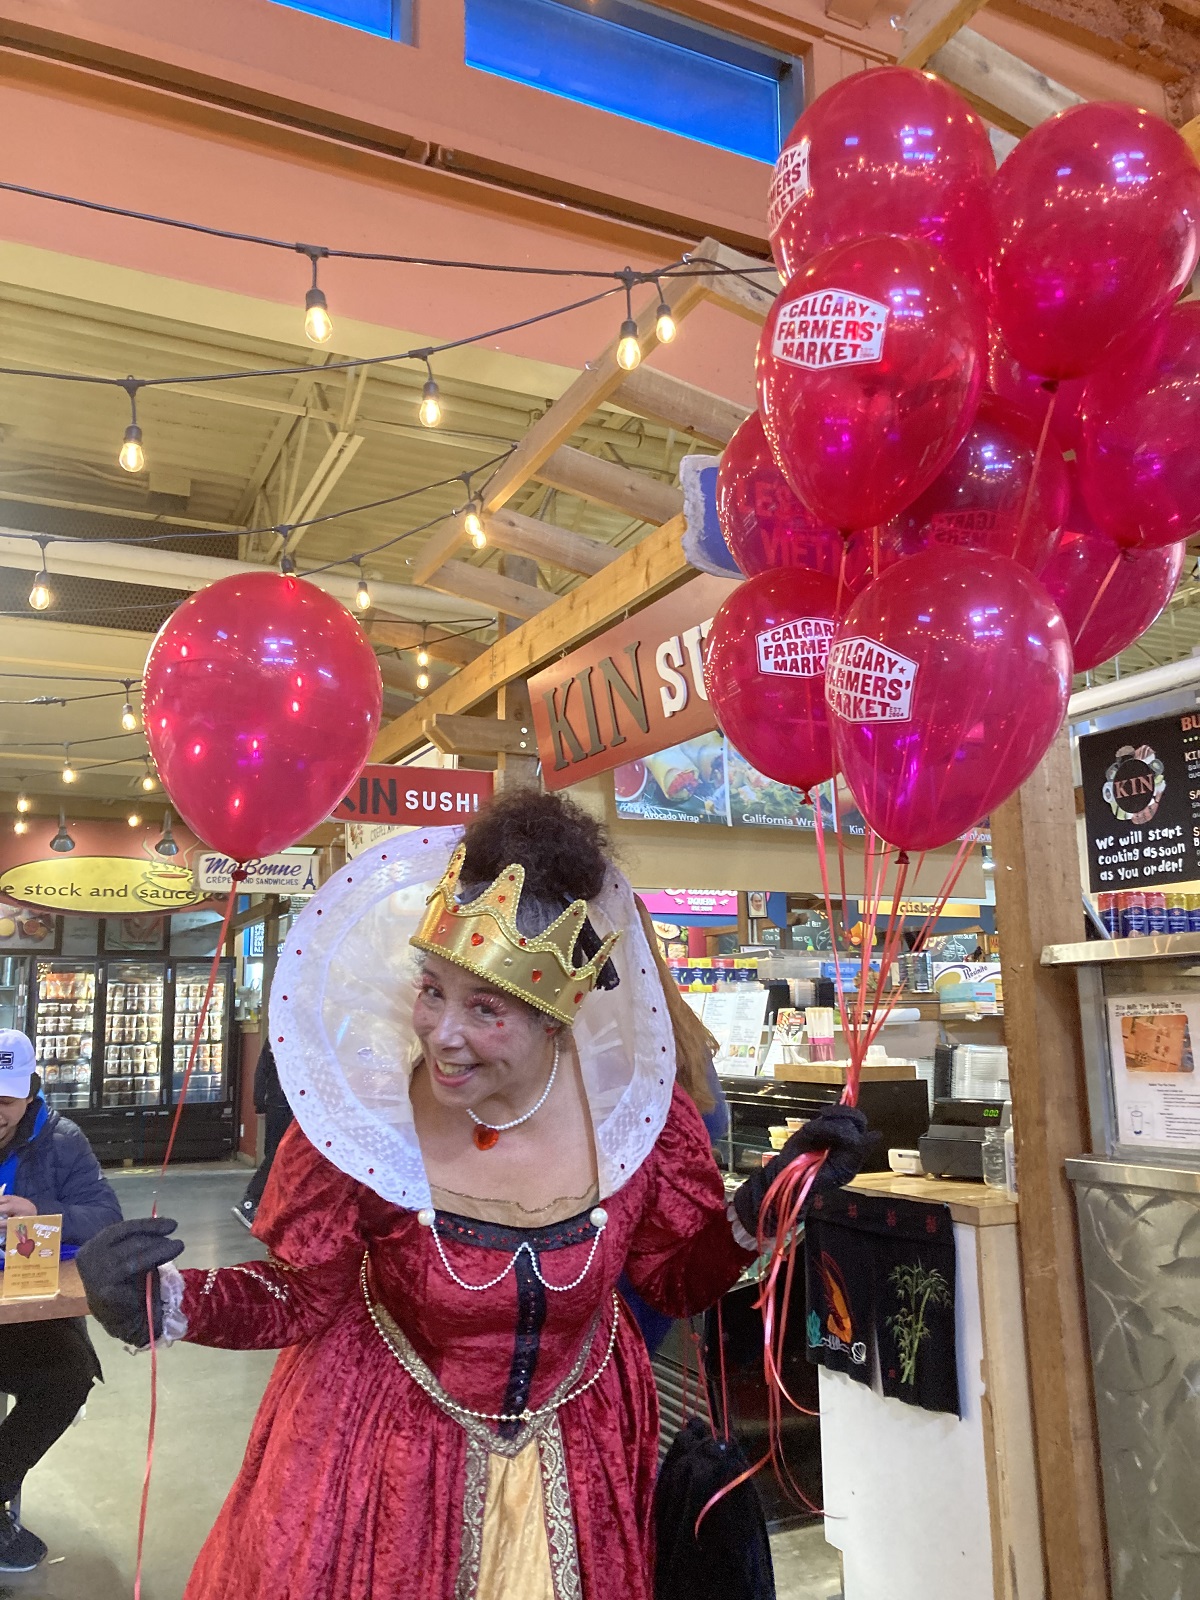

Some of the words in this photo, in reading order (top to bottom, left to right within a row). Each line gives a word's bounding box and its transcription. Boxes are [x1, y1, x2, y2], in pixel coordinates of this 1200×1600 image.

[789, 294, 870, 318] CALGARY
[777, 319, 882, 342] FARMERS'
[782, 341, 862, 365] MARKET
[770, 621, 837, 643] CALGAR
[764, 639, 833, 661] FARME
[832, 642, 899, 675] CALGARY
[774, 656, 829, 675] MARK
[826, 663, 911, 701] FARMERS'
[542, 641, 649, 771] KIN
[828, 687, 890, 719] MARKET
[1181, 714, 1200, 731] BU
[1114, 774, 1155, 798] KIN
[405, 790, 479, 812] SUSHI
[643, 812, 677, 821] Avocado
[678, 813, 700, 823] Wrap
[743, 814, 793, 825] California
[1119, 831, 1142, 847] will
[1148, 826, 1182, 841] start
[1098, 848, 1139, 865] cooking
[1143, 847, 1157, 858] as
[1159, 843, 1185, 857] soon
[205, 857, 236, 874] Ma
[245, 859, 302, 876] Bonne
[1100, 870, 1113, 880] as
[1143, 858, 1183, 876] order!
[24, 883, 82, 897] stock
[90, 885, 128, 898] and
[140, 887, 196, 899] sauce
[206, 876, 233, 884] CRÊPE
[255, 878, 299, 886] SANDWICHES
[963, 965, 988, 980] Resinite
